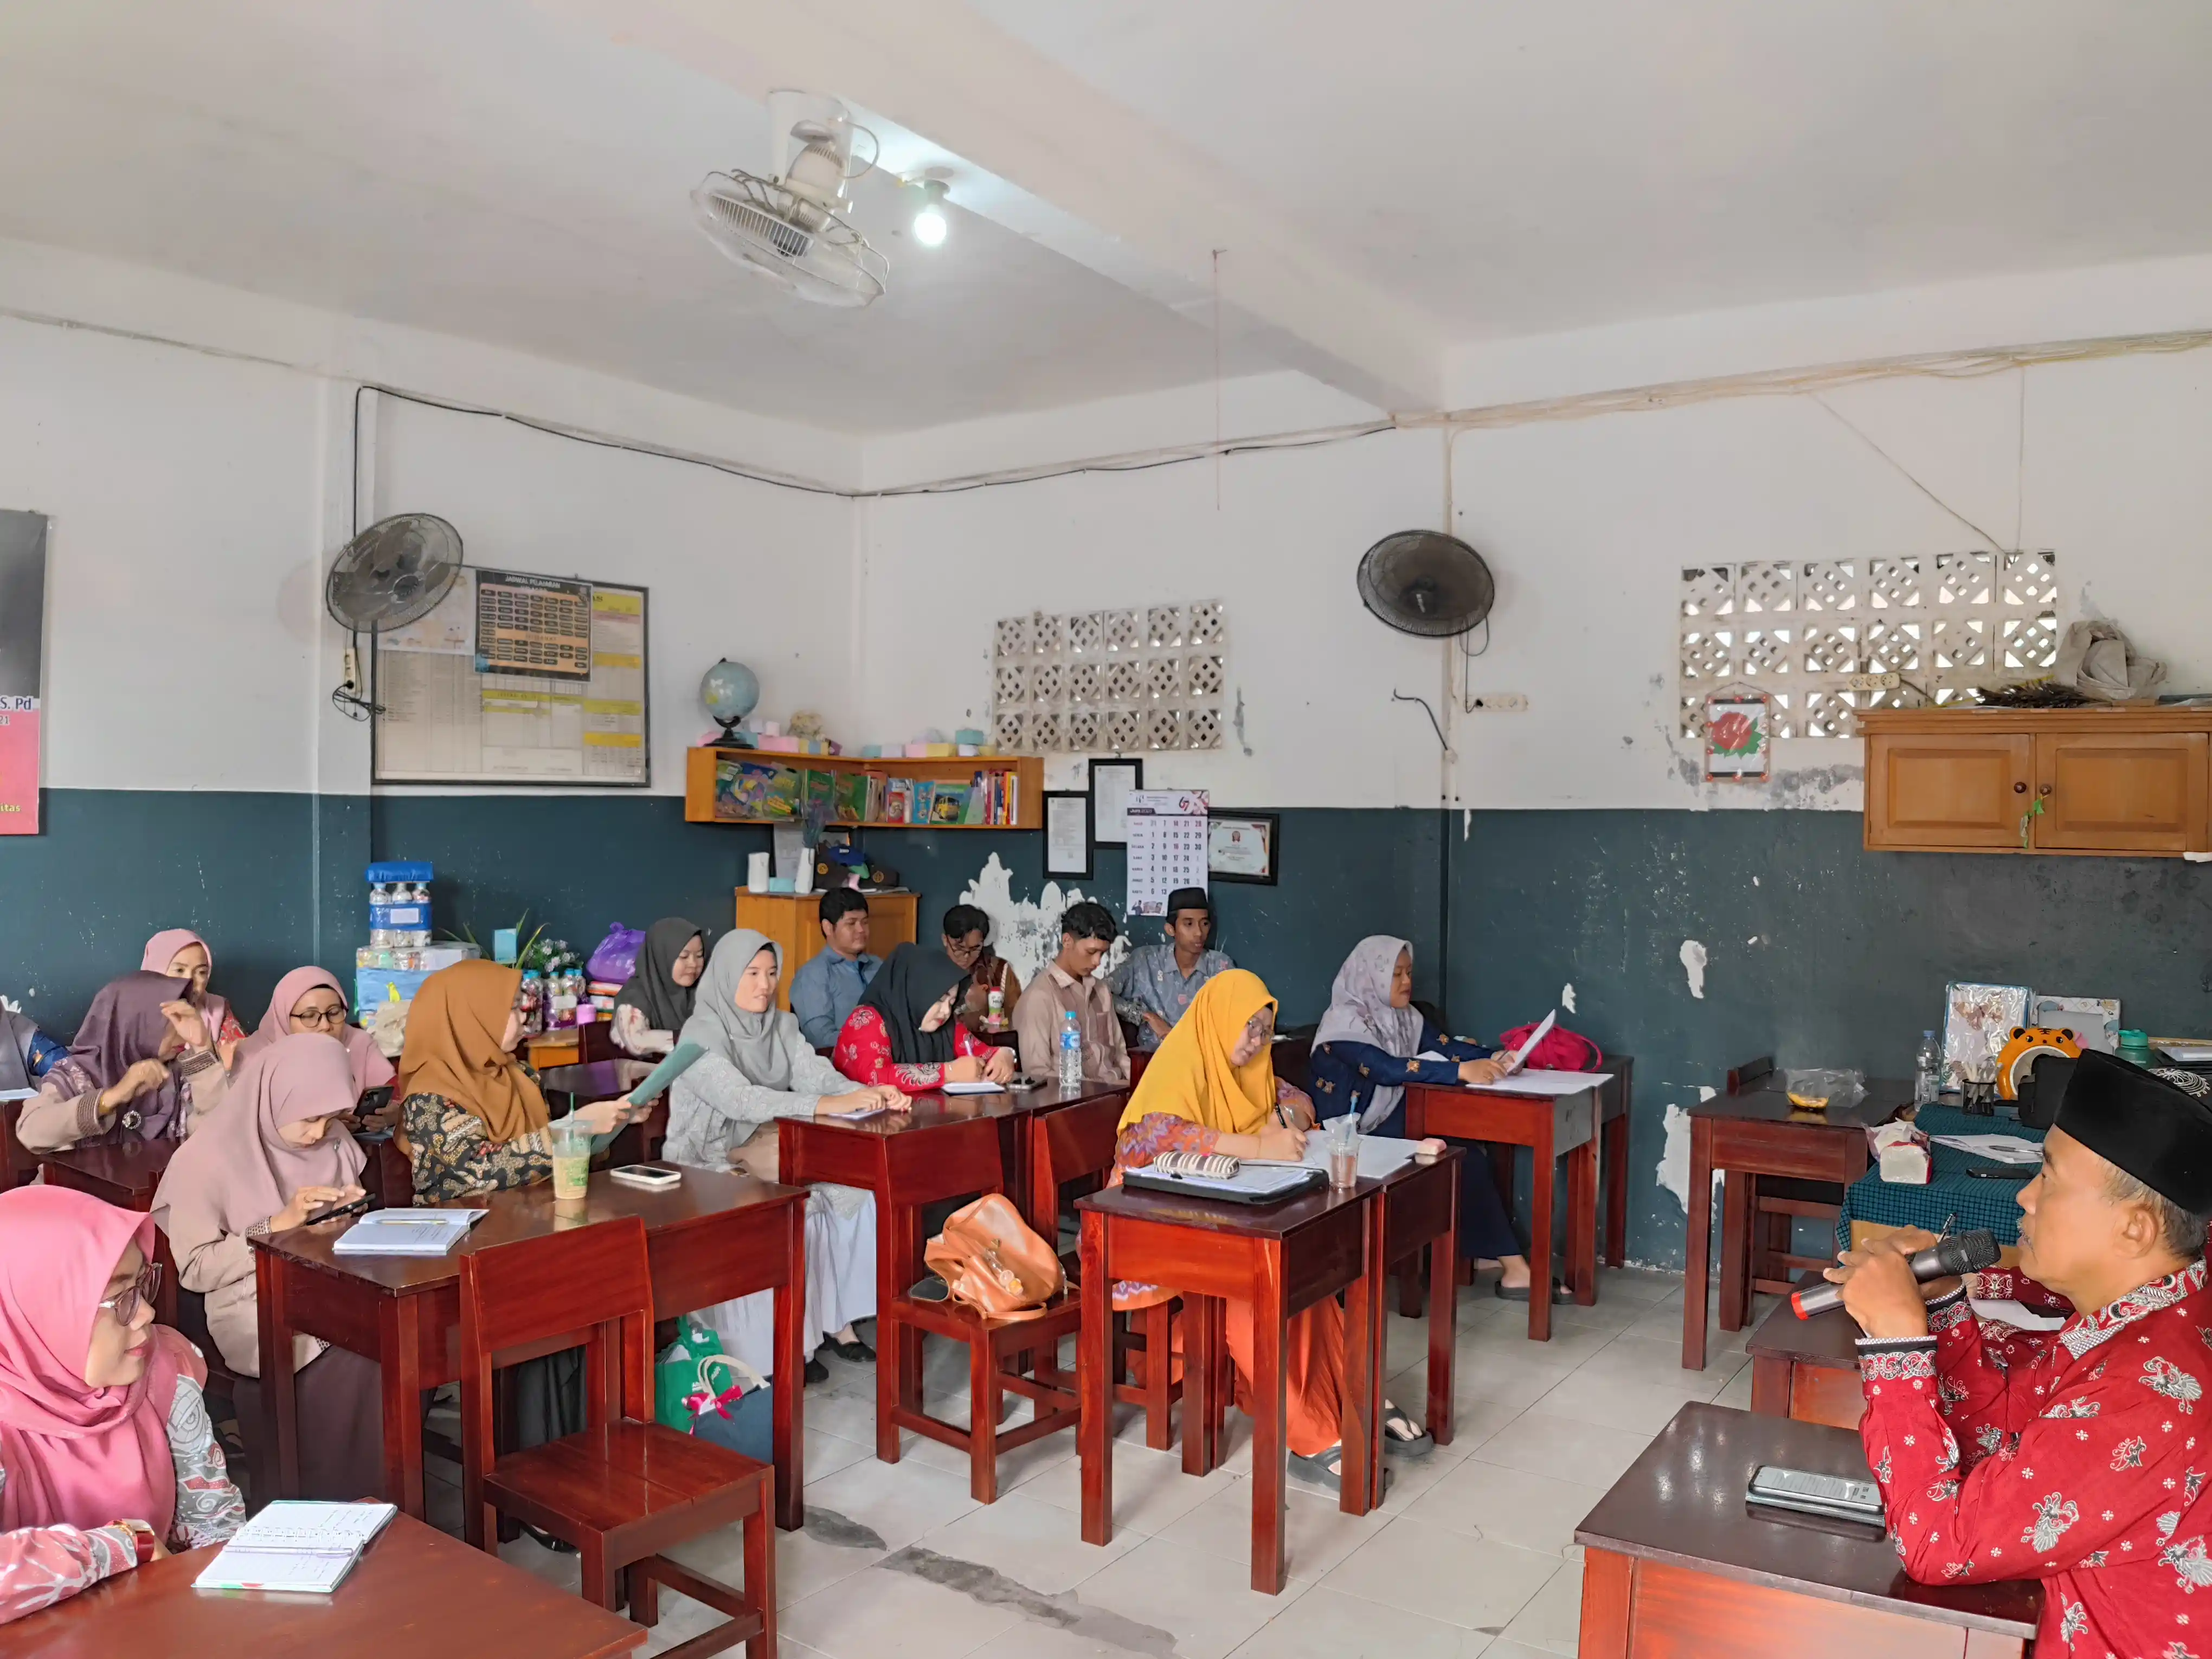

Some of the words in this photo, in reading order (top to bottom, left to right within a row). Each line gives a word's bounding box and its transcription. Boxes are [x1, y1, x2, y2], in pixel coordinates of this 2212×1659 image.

[505, 575, 528, 584] JADWAL
[530, 578, 561, 588] PELAJARAN
[1, 697, 10, 709] S.
[16, 698, 31, 710] Pd
